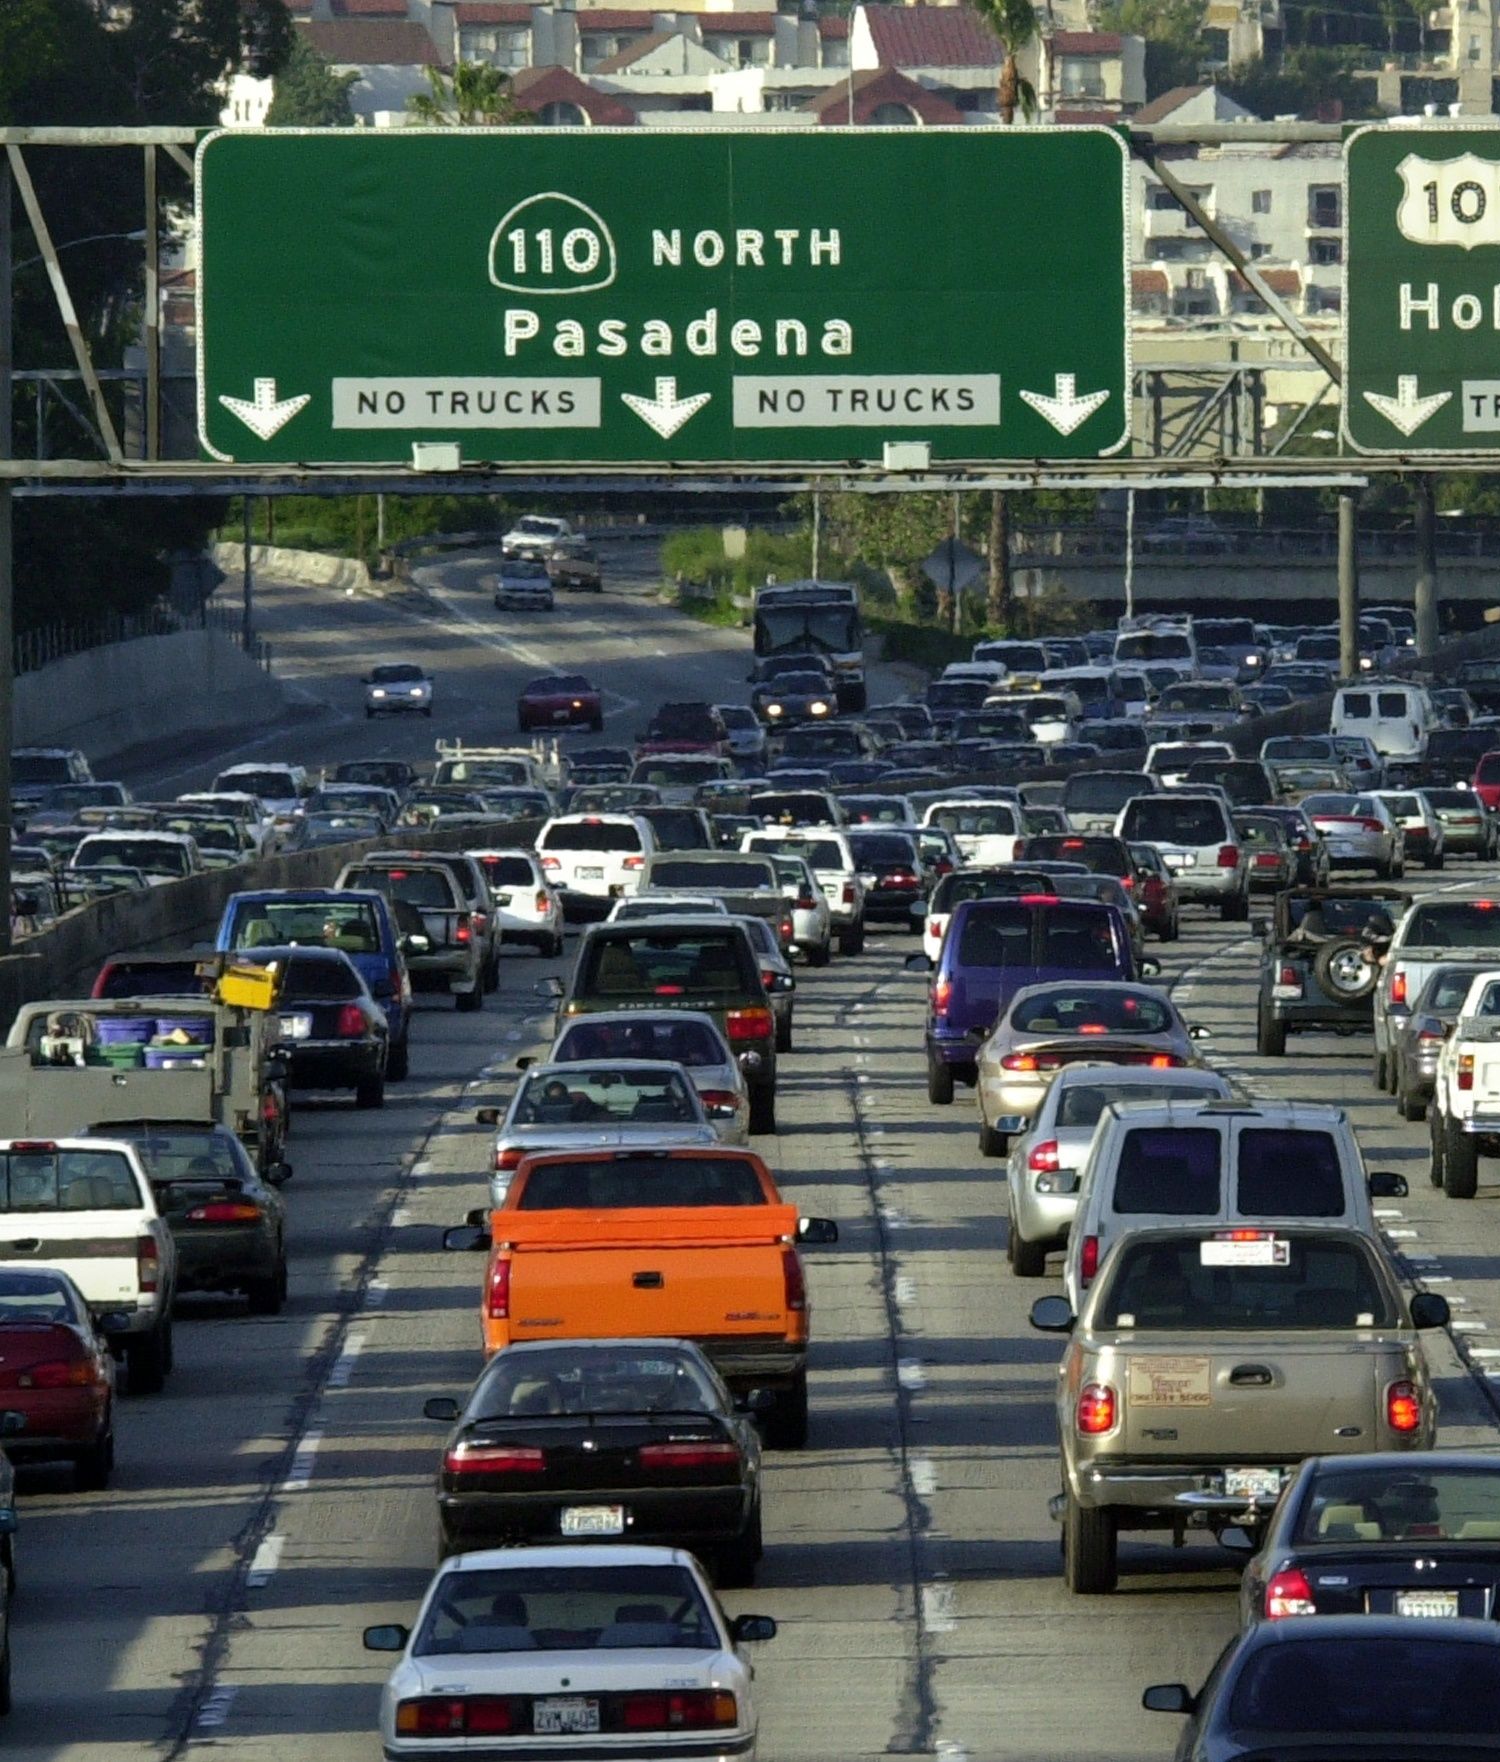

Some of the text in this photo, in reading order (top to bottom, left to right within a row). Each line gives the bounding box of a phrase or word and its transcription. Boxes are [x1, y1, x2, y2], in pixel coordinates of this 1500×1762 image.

[504, 228, 842, 274] 110 NORTH
[504, 308, 854, 357] Pasadena
[357, 390, 576, 415] NO TRUCKS
[757, 387, 976, 414] NO TRUCKS
